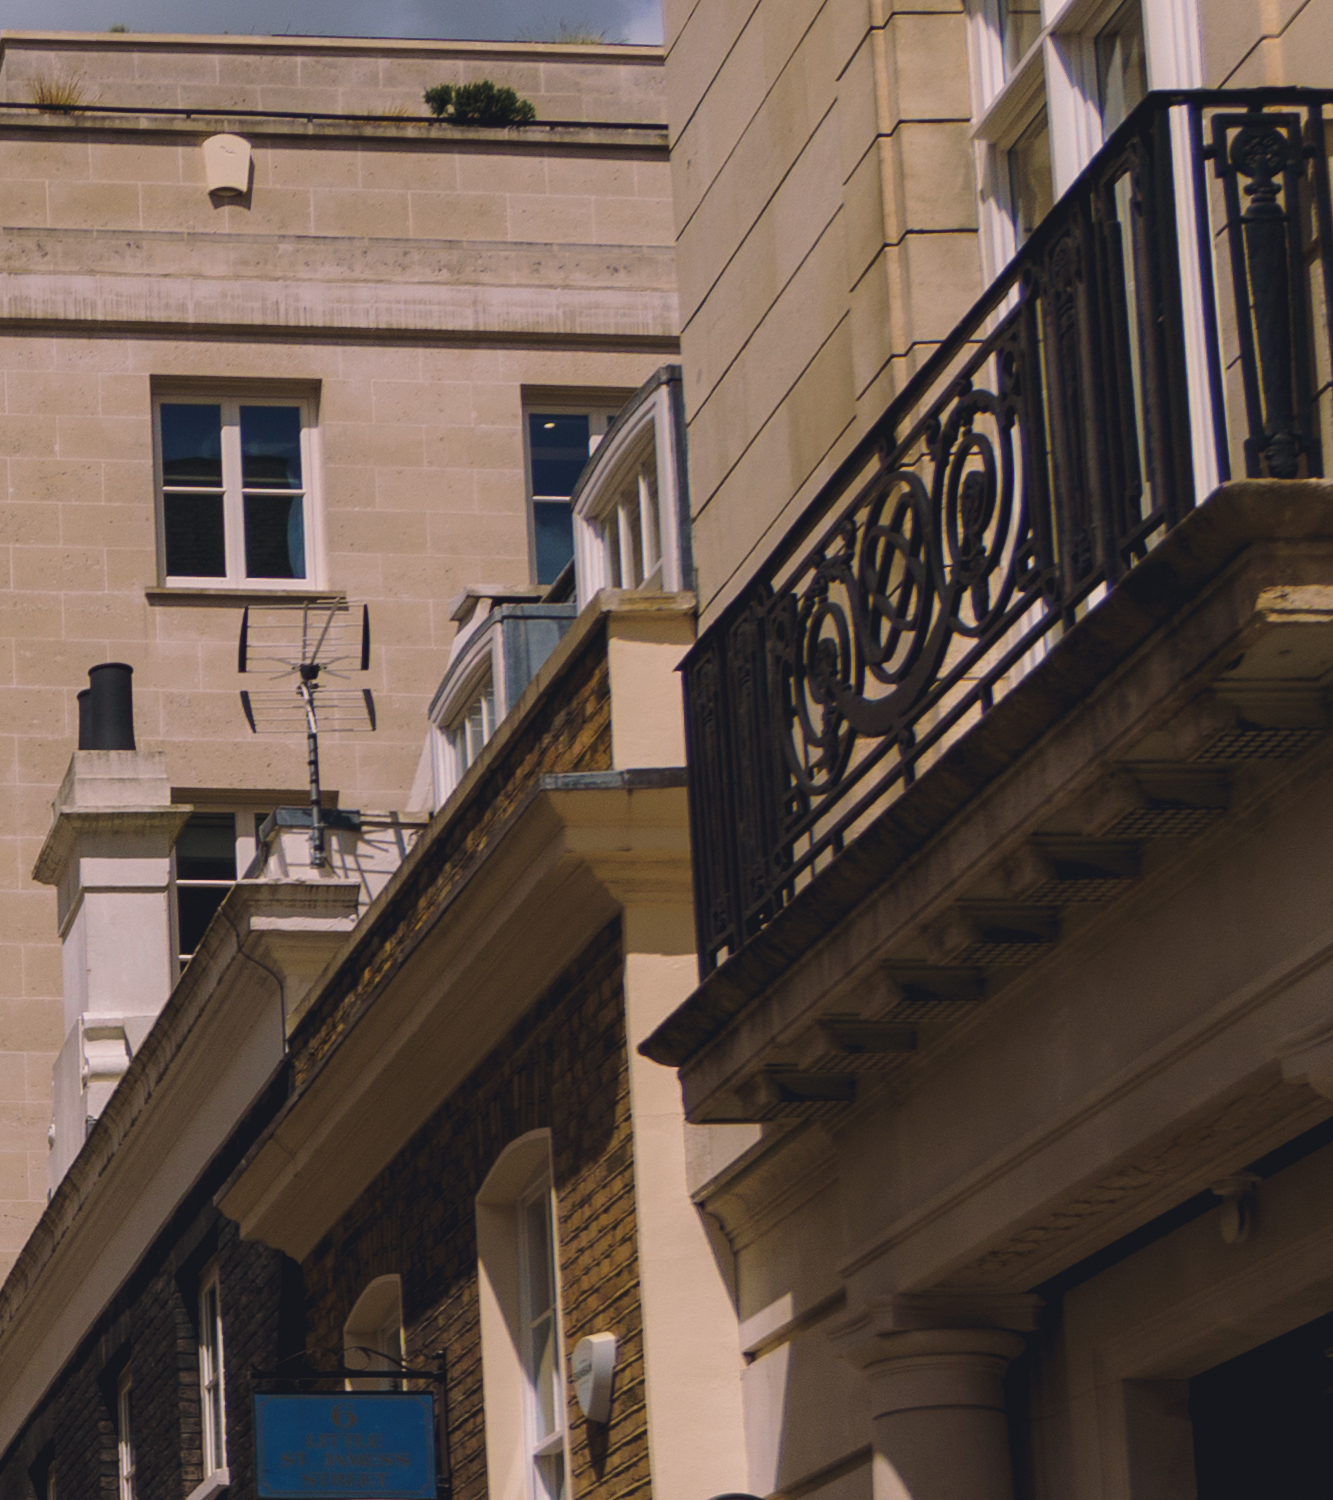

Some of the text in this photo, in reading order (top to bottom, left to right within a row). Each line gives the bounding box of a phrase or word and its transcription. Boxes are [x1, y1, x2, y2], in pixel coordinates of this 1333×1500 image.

[330, 1402, 358, 1429] 6
[306, 1432, 384, 1449] LITTLE
[279, 1451, 316, 1468] ST.
[301, 1471, 390, 1488] STREET
